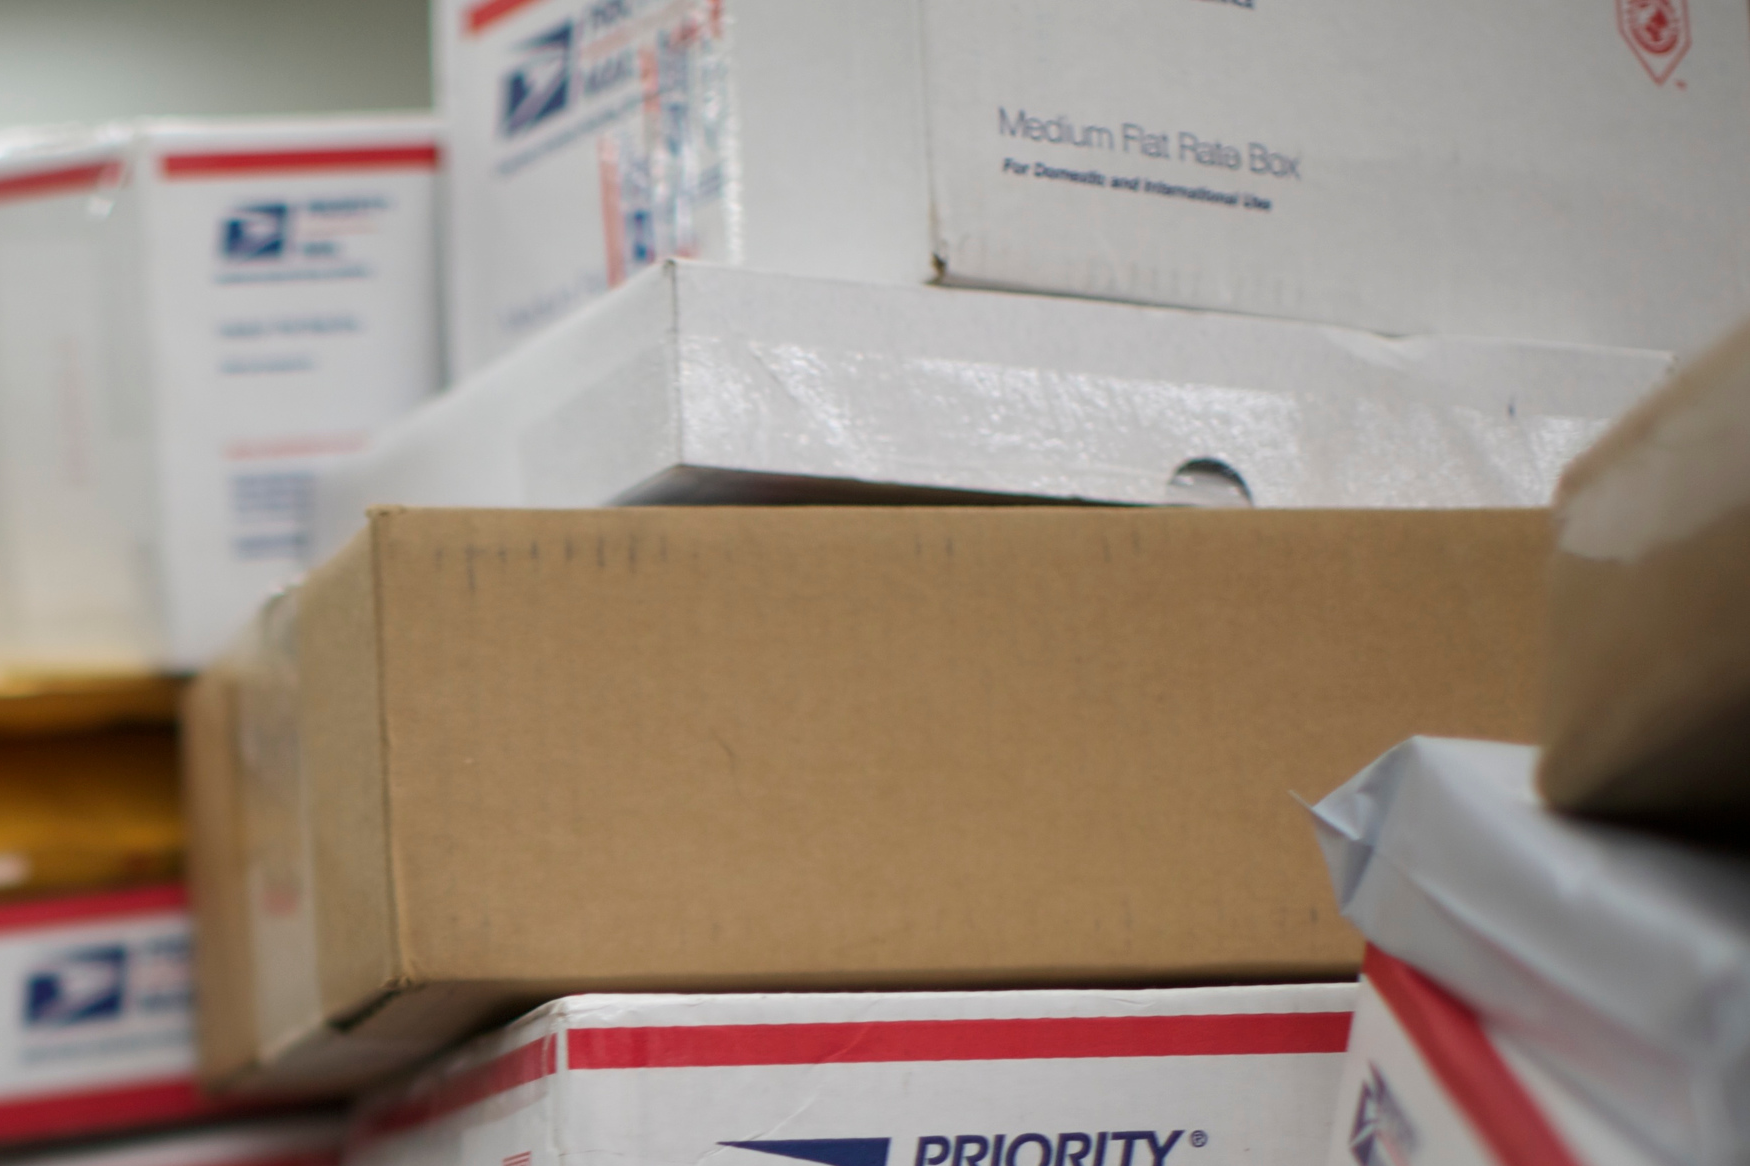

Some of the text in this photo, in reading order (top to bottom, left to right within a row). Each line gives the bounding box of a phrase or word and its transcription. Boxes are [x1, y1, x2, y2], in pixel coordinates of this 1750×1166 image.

[998, 105, 1115, 151] Medium
[1177, 130, 1242, 171] Rate
[1247, 141, 1303, 180] Box
